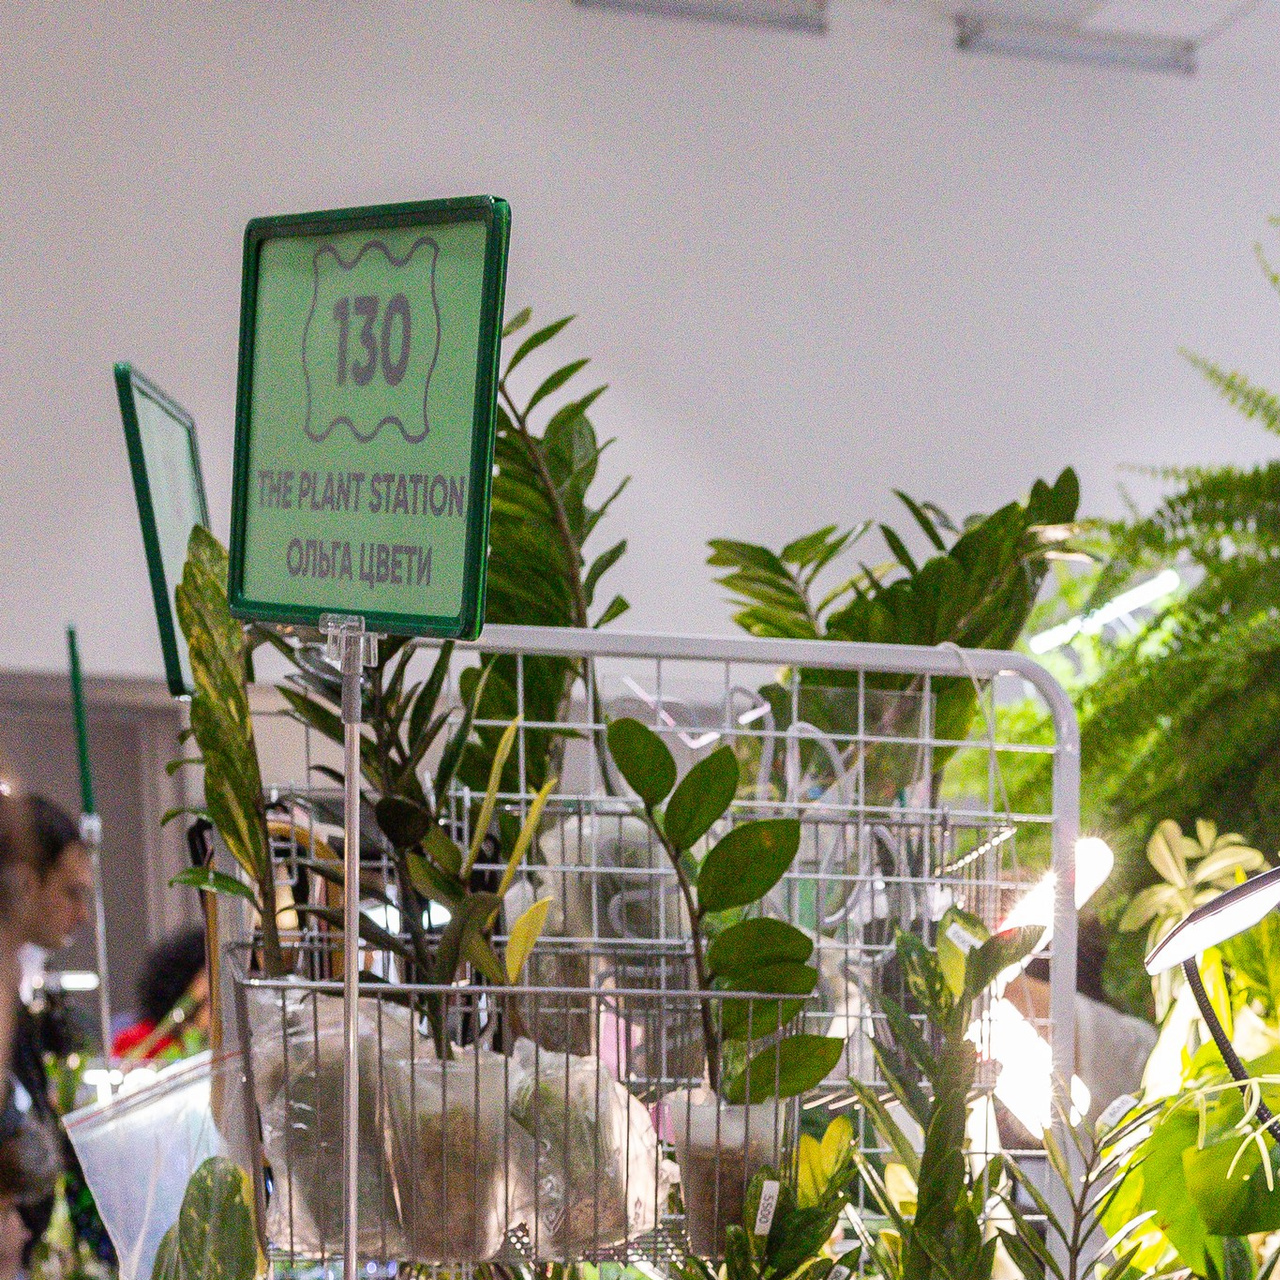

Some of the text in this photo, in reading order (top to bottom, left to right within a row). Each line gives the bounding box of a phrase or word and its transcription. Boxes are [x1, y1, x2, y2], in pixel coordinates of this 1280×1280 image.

[333, 292, 411, 387] 130
[257, 470, 467, 518] THE PLANT STATION
[286, 537, 433, 589] ОЛЬГА ЦВЕТИ
